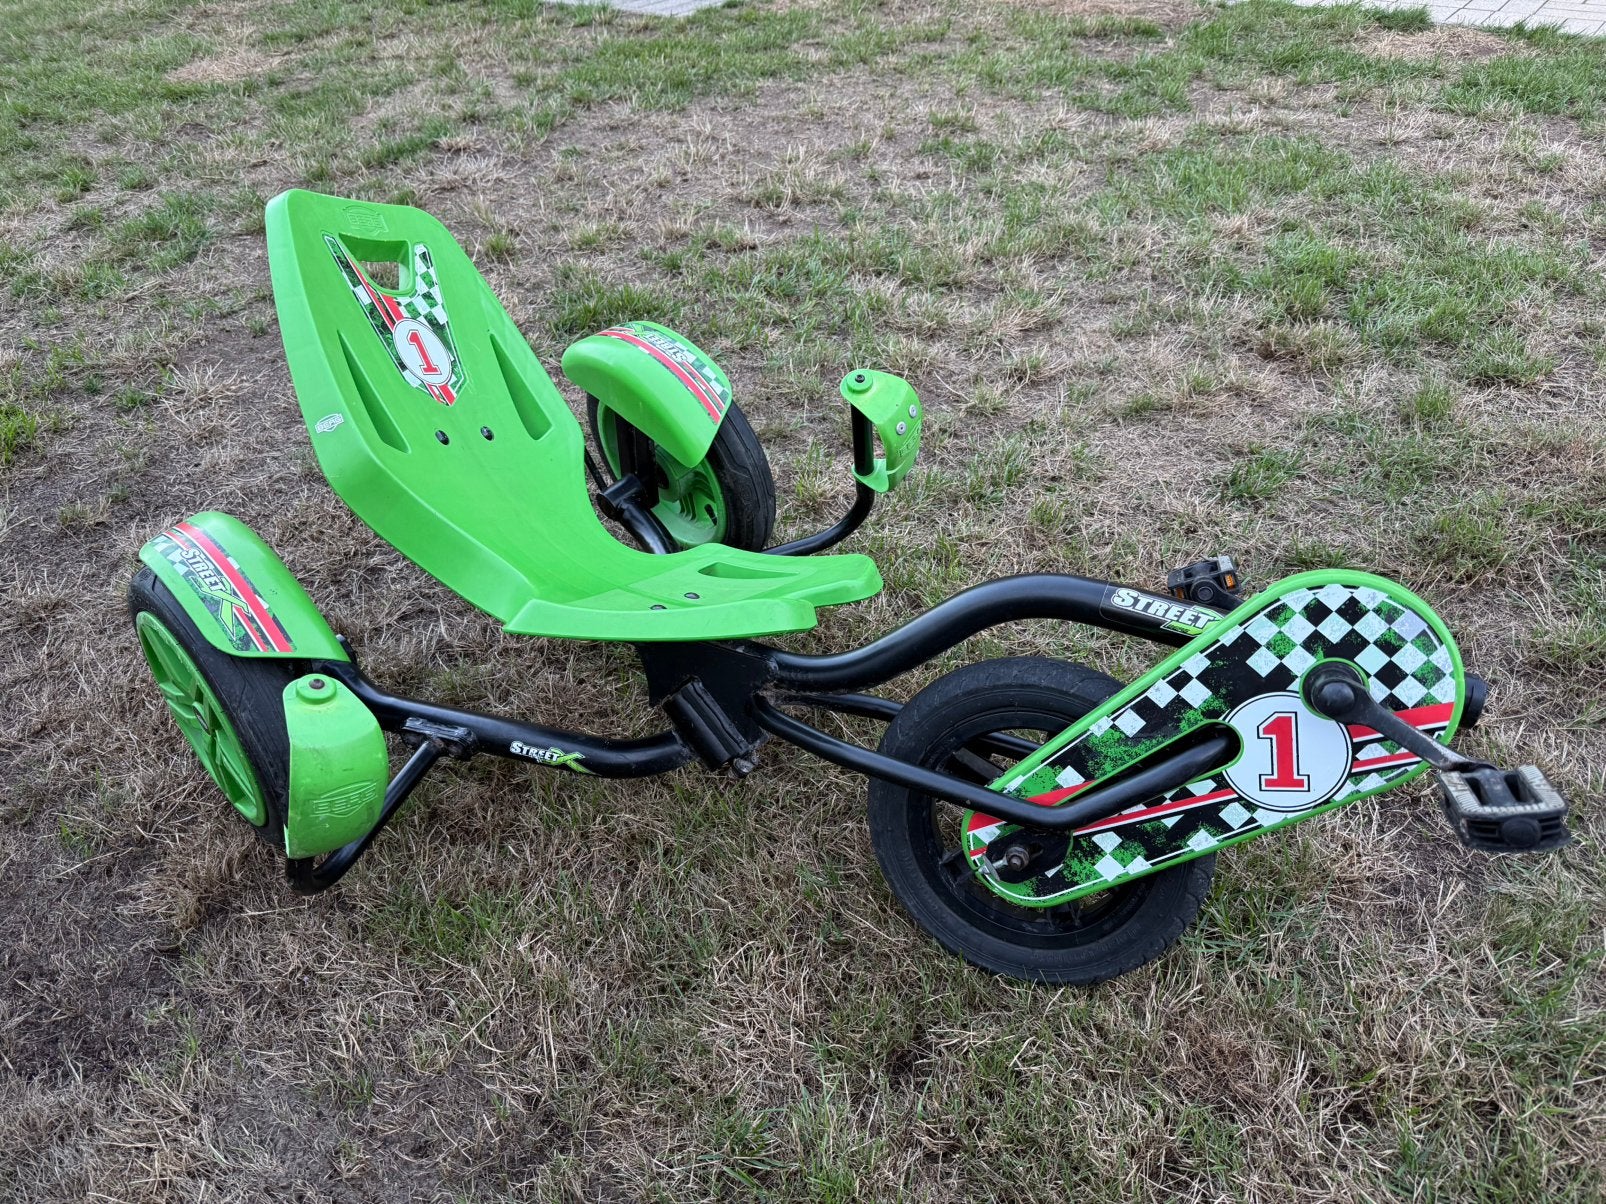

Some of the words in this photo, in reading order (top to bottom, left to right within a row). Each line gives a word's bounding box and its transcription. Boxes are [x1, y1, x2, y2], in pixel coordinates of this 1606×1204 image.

[407, 330, 442, 375] 1
[181, 547, 225, 592] STREET
[1111, 588, 1215, 629] STREET
[509, 740, 560, 763] STREET
[1256, 710, 1311, 793] 1
